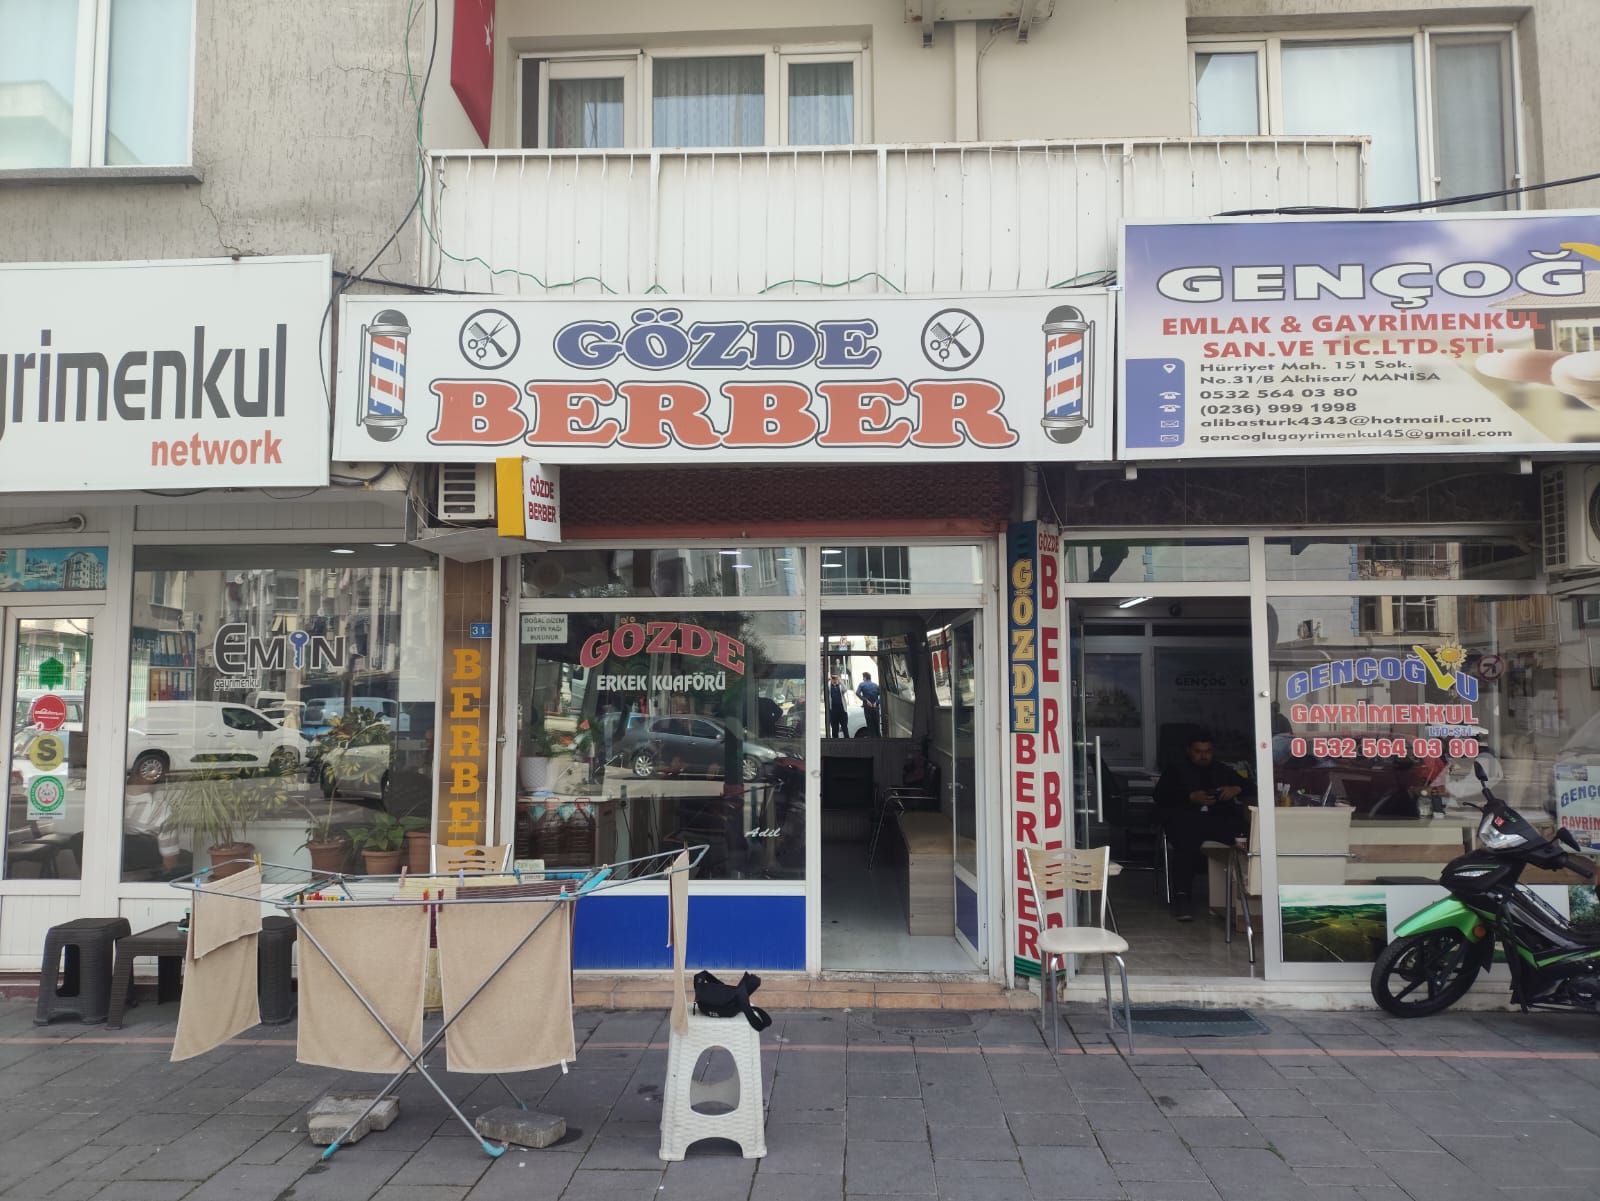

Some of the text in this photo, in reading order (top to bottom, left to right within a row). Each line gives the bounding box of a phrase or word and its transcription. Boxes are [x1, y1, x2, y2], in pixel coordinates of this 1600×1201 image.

[1162, 309, 1545, 336] EMLAK & GAYRİMENKUL
[553, 307, 882, 371] GÖZDE
[1203, 333, 1505, 359] SAN.VE TİC.LTD.ŞTİ.
[1200, 360, 1413, 373] Hürriyet Mah. 151 Sok.
[1200, 371, 1441, 385] No.31/B Akhisar/ MANİSA
[1200, 388, 1358, 400] 0532 564 03 80
[427, 378, 1020, 449] BERBER
[1200, 402, 1357, 416] (0236) 999 1998
[1200, 415, 1492, 427] alibasturk4343@hotmail.com
[1199, 429, 1513, 443] gencoglugayrimenkul45@gmail.com
[151, 430, 283, 466] network
[529, 475, 555, 500] GÖZDE
[528, 501, 557, 523] BERBER
[472, 626, 485, 636] 31
[579, 616, 745, 676] GÖZDE
[597, 671, 726, 693] ERKEK KUAFÖRÜ
[1291, 701, 1479, 725] GAYRİMENKUL
[447, 648, 482, 848] BERBE
[1291, 738, 1479, 758] 0 532 564 03 80
[1560, 784, 1600, 808] GENÇ
[744, 827, 781, 838] Adil
